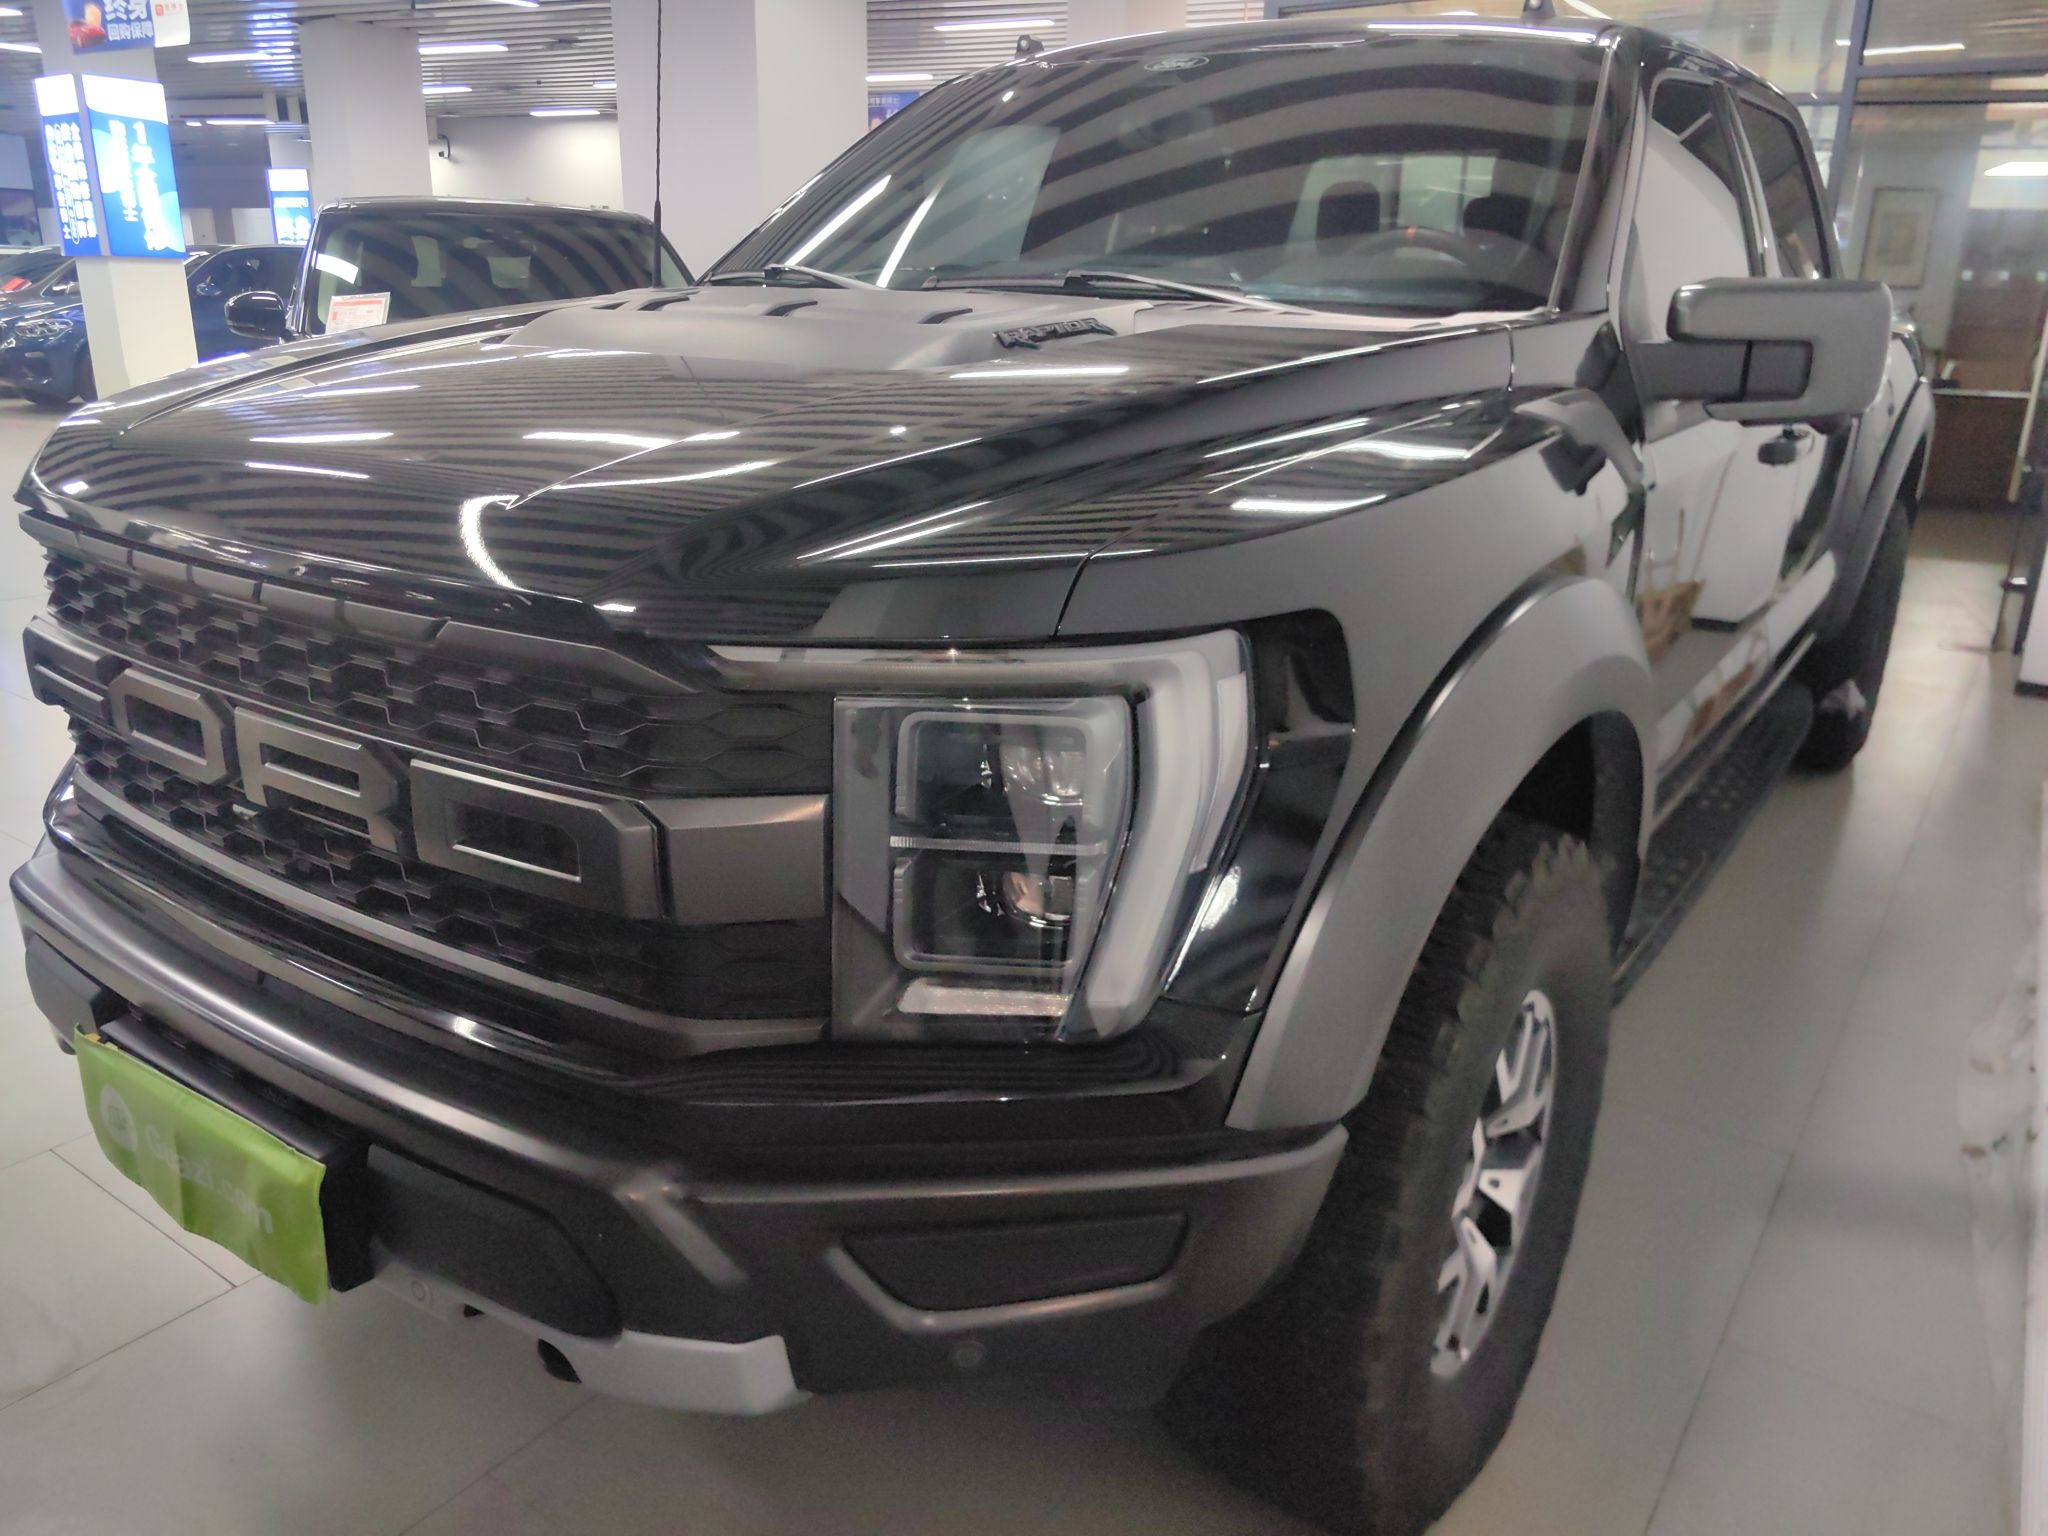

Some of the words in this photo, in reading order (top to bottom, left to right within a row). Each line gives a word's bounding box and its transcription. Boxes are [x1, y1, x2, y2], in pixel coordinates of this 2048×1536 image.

[107, 20, 154, 41] 回购保障
[993, 317, 1118, 349] RAPTOR
[23, 614, 656, 922] FORD
[145, 1124, 274, 1236] Guazi.com
